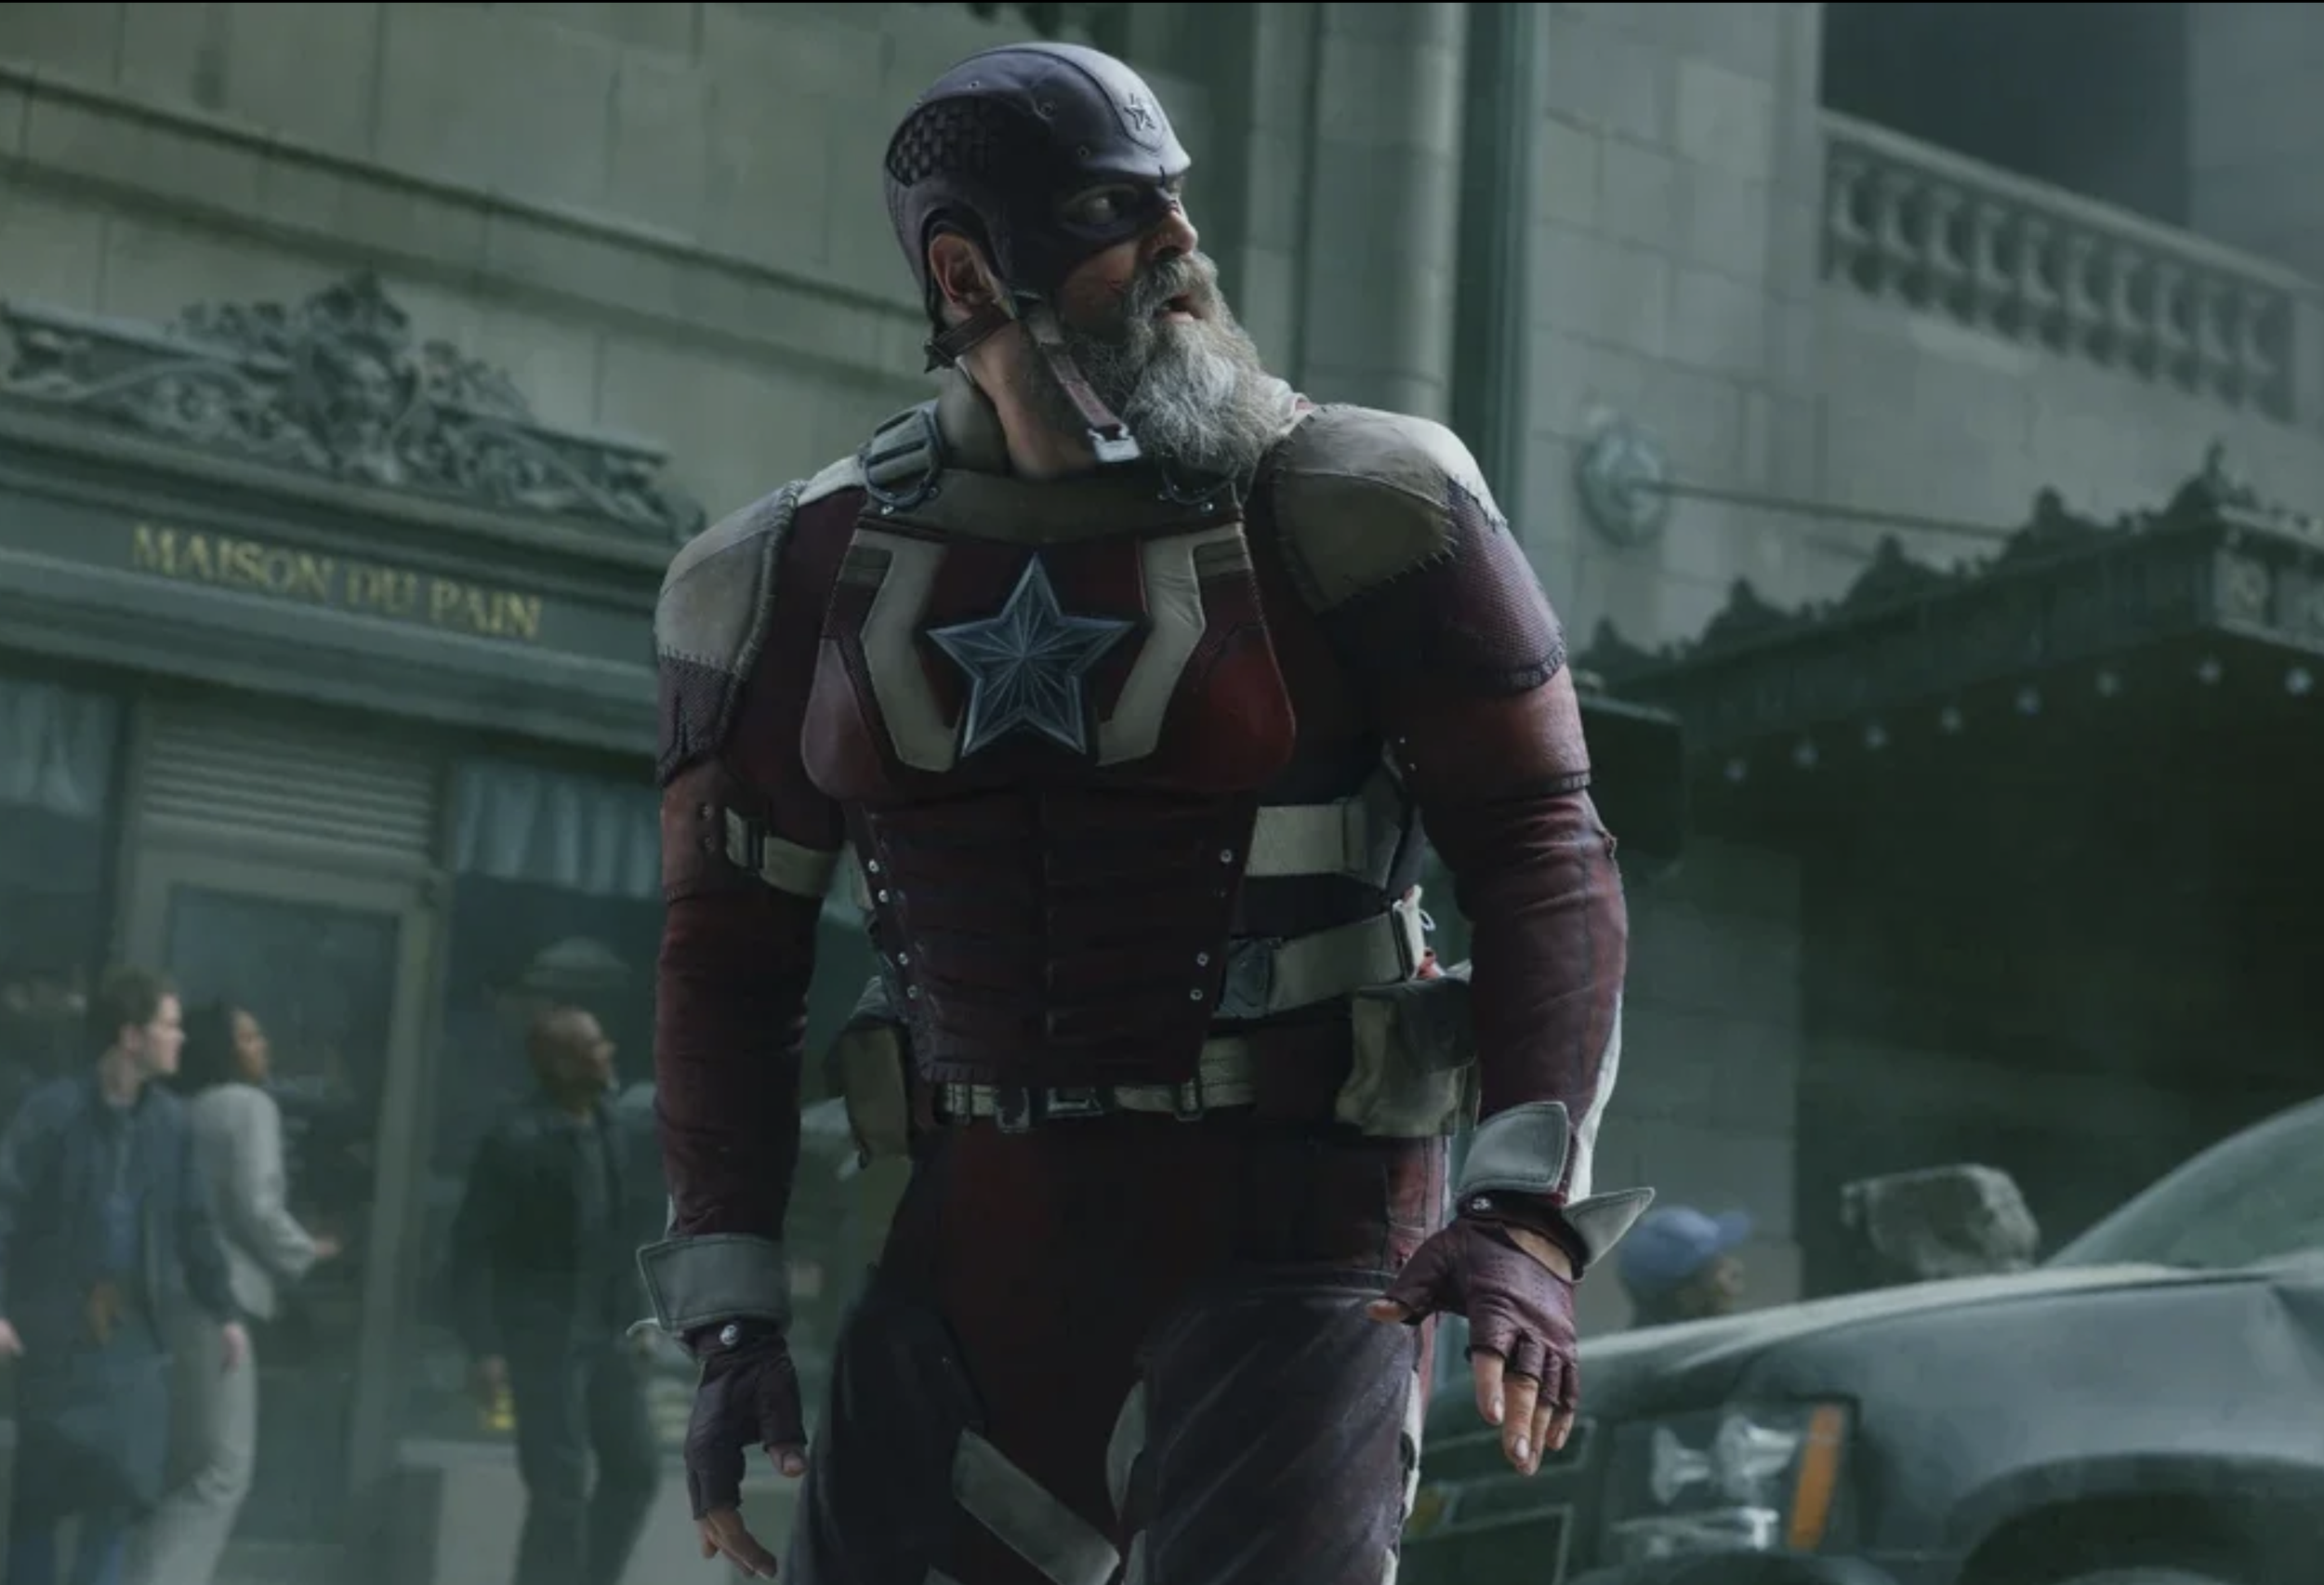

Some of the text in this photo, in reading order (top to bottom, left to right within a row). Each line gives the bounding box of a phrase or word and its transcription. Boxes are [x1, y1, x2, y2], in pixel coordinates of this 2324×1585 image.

[132, 523, 542, 639] MAISON DU PAIN
